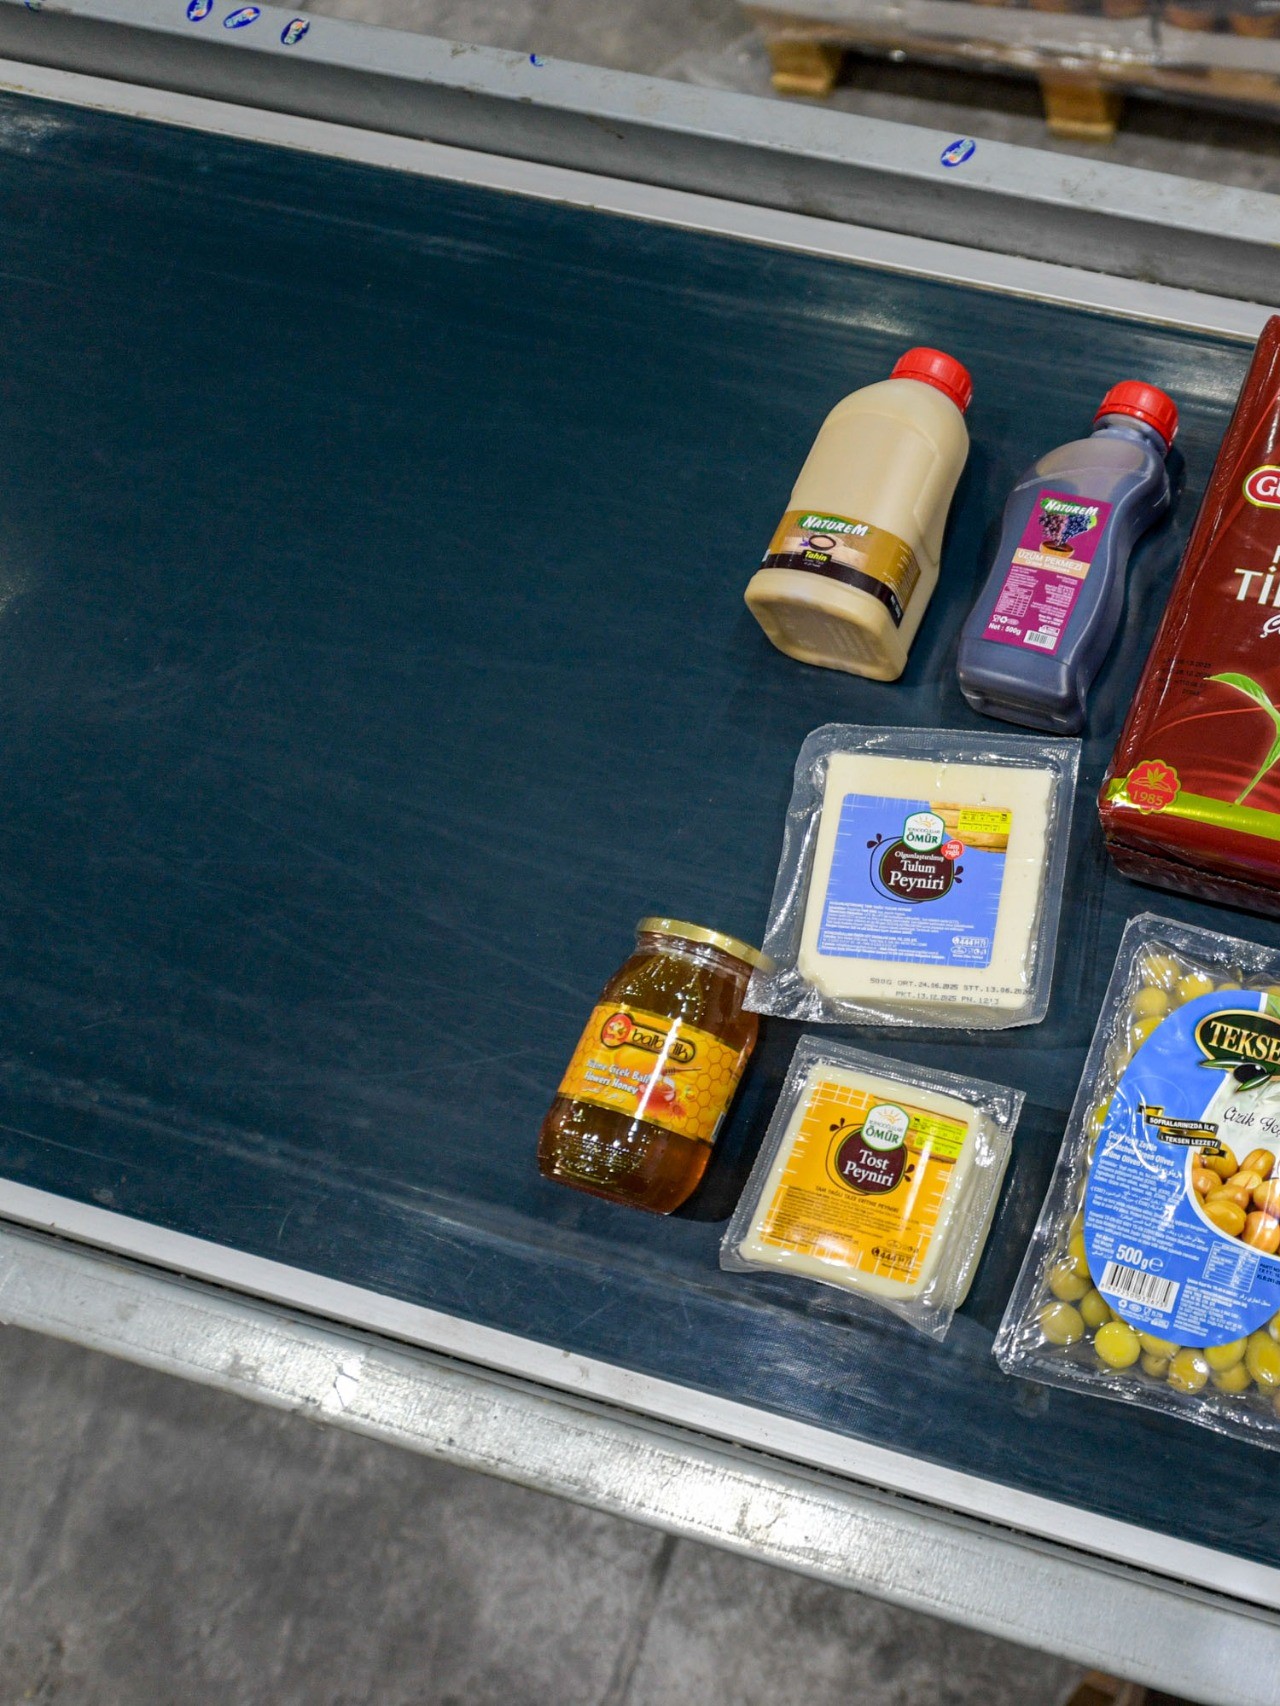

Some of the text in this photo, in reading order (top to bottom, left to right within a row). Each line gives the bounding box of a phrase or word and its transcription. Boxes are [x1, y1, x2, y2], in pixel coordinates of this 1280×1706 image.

[1044, 500, 1099, 516] NATUREM
[802, 514, 869, 537] NATUREM
[804, 550, 828, 562] Tahin
[1133, 790, 1164, 806] 1985
[906, 832, 938, 844] ÖMÜR
[900, 859, 936, 874] Tulum
[888, 870, 945, 892] Peyniri
[612, 1080, 639, 1095] Honey
[1223, 1106, 1255, 1126] Çizik
[1150, 1117, 1215, 1132] SOFRALARINIZDA İLK
[865, 1125, 900, 1144] ÖMÜR
[1165, 1135, 1218, 1147] TEKSEN LEZZETİ
[860, 1149, 889, 1170] Tost
[843, 1161, 895, 1187] Peyniri
